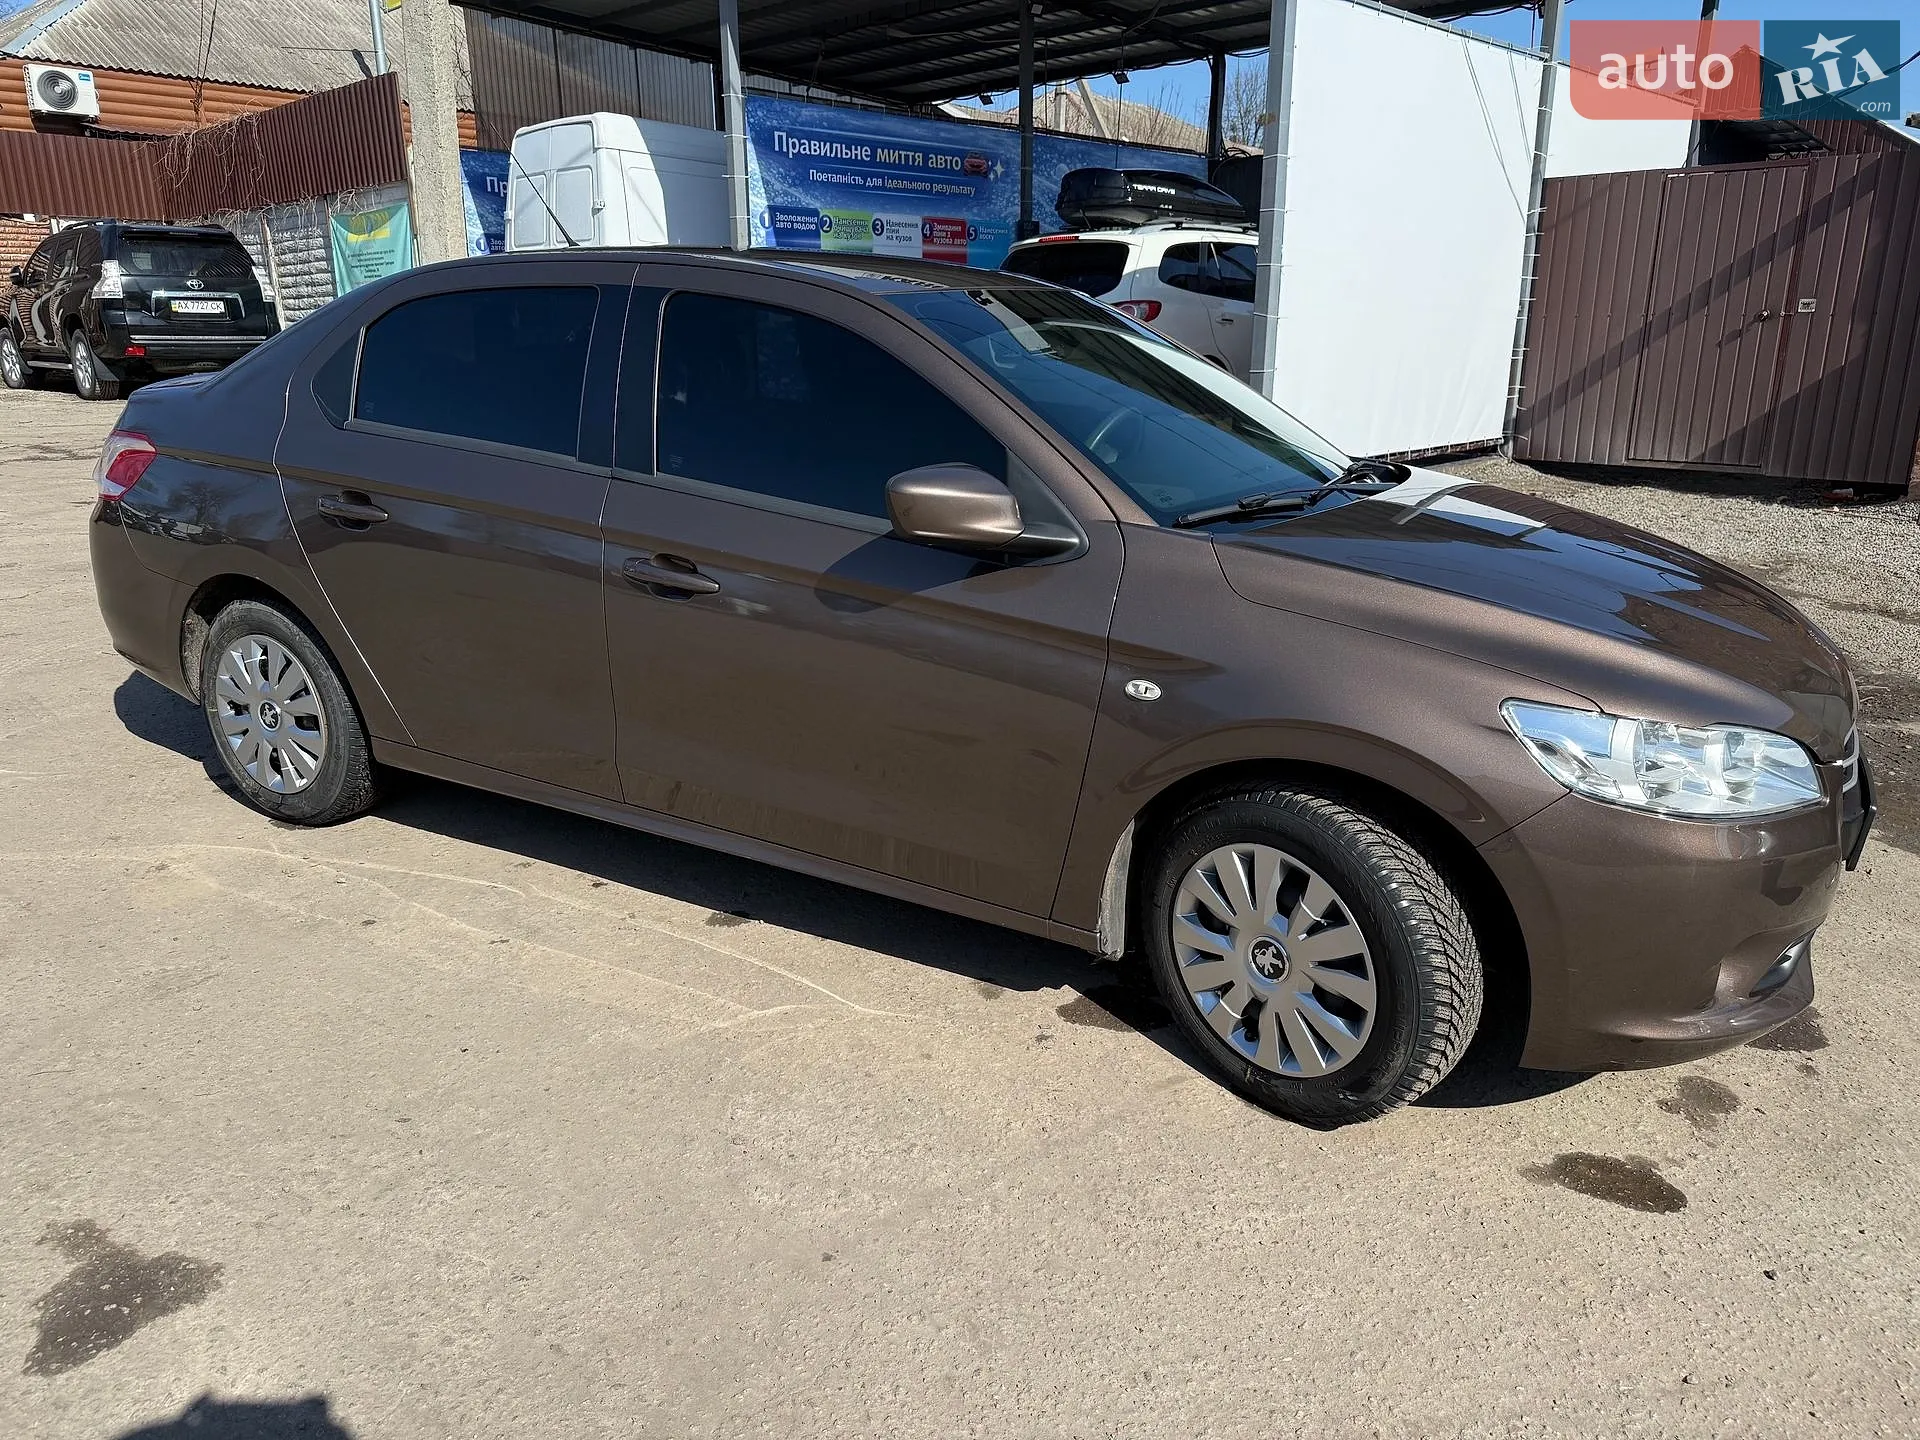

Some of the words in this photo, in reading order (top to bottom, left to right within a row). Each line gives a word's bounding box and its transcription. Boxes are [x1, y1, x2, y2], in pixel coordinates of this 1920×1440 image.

[774, 131, 871, 161] Правильне
[876, 149, 923, 166] миття
[928, 154, 961, 170] авто
[809, 170, 864, 185] Поетапність
[865, 176, 882, 187] для
[884, 176, 930, 191] ідеального
[932, 182, 976, 196] результату
[762, 212, 769, 228] 1
[775, 212, 818, 223] Зволоження
[885, 218, 919, 229] Нанесення
[793, 223, 816, 231] водою
[822, 217, 830, 231] 2
[874, 220, 882, 234] 3
[923, 224, 931, 236] 4
[895, 235, 912, 243] кузов
[968, 227, 976, 239] 5
[478, 239, 486, 251] 1
[177, 301, 190, 310] AX
[191, 301, 209, 310] 7727
[210, 302, 223, 310] CK
